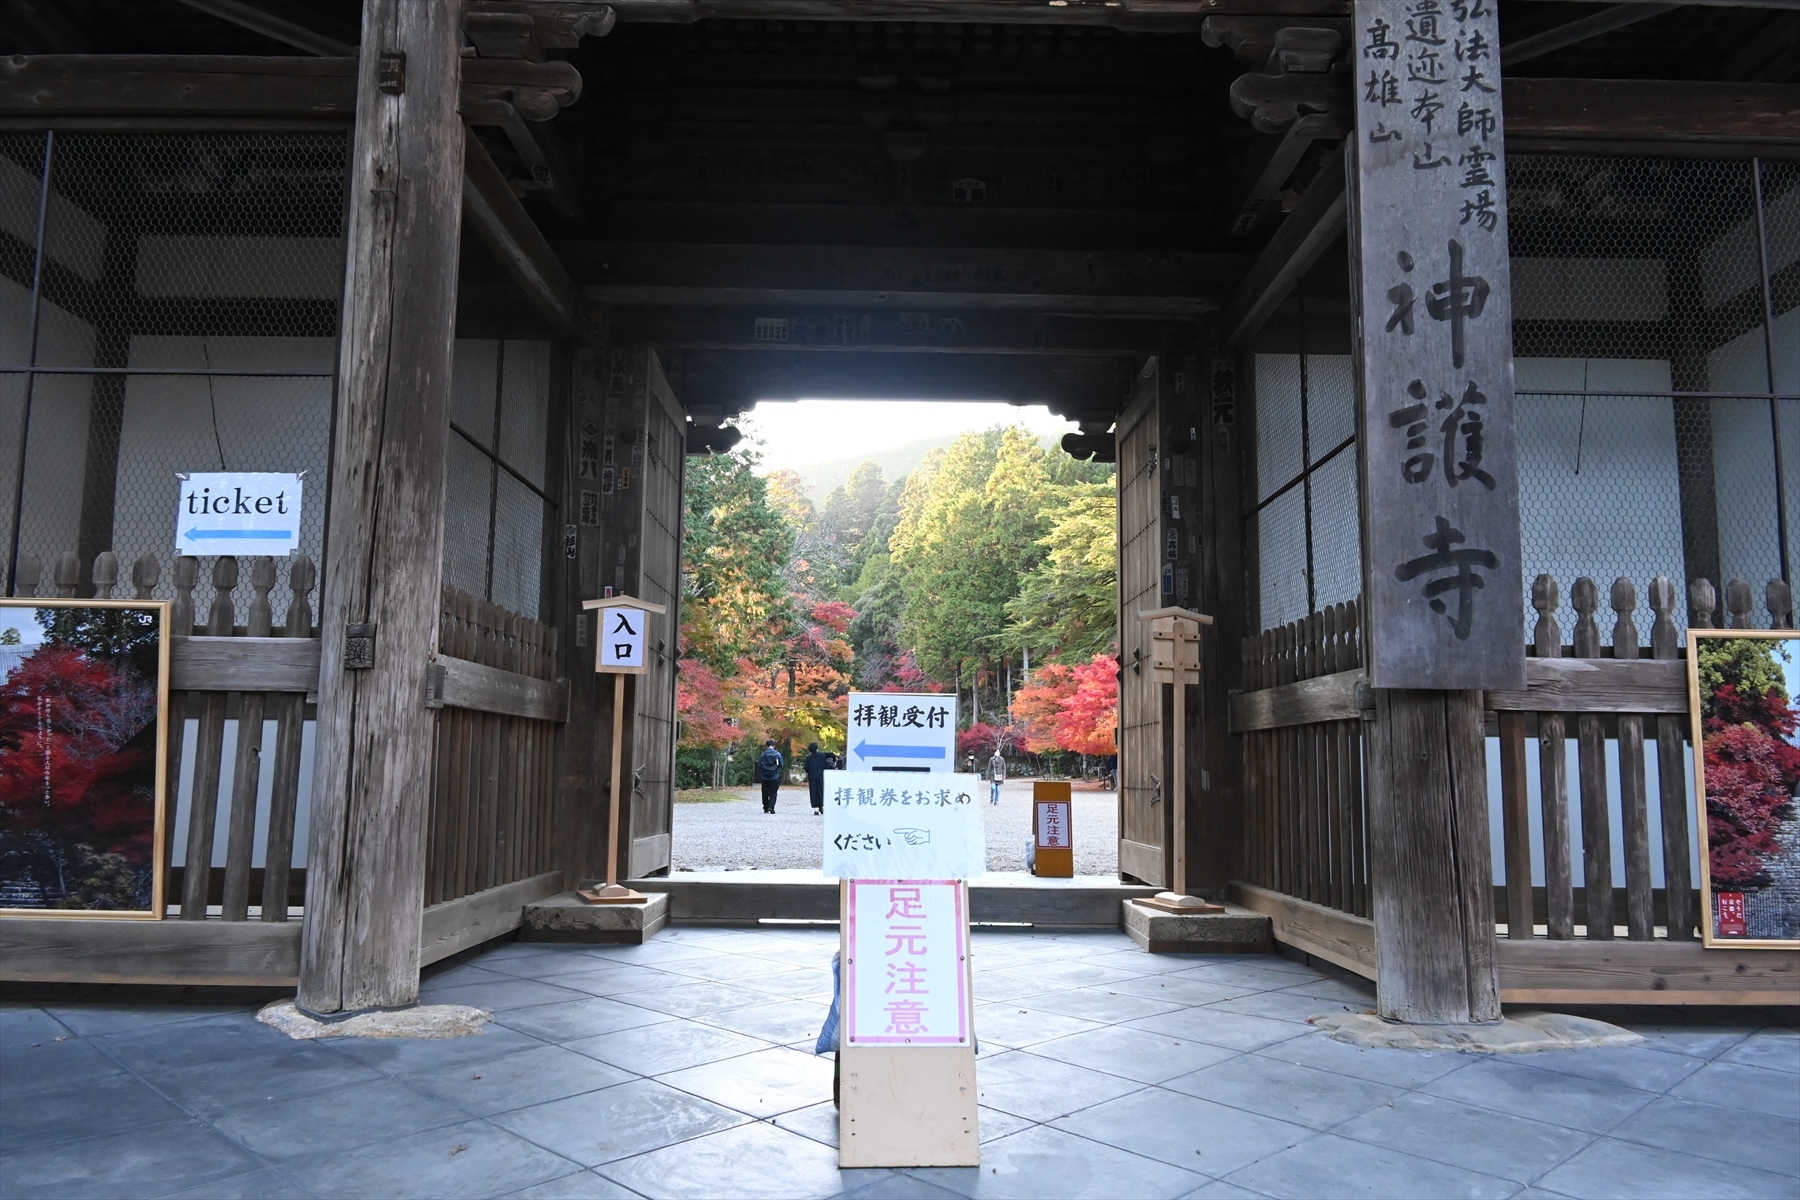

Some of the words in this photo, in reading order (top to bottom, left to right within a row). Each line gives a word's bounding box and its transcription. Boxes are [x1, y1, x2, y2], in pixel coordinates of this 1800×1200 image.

[1451, 0, 1498, 232] 弘法大師霊場
[1384, 237, 1501, 642] 神護寺
[186, 486, 289, 516] ticket
[138, 615, 153, 624] JR
[612, 612, 637, 660] 入口
[853, 703, 950, 729] 拝観受付
[834, 787, 972, 807] 拝観券をお求め
[833, 832, 892, 852] ください
[1046, 803, 1060, 846] 足元注意
[883, 887, 930, 1035] 足元注意
